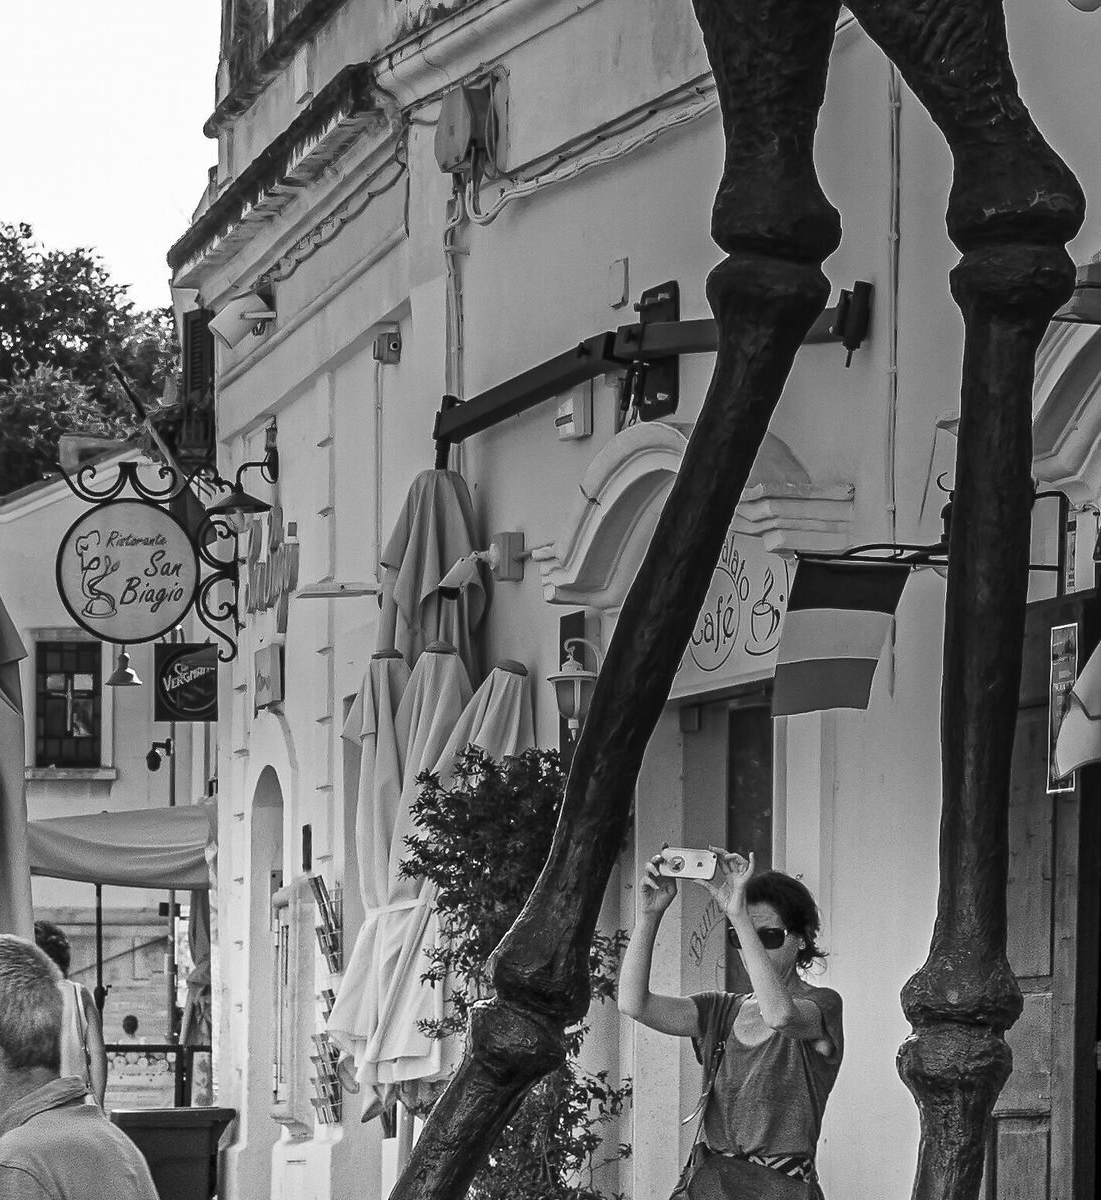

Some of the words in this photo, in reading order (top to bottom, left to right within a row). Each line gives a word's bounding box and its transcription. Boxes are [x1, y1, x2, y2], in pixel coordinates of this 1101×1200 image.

[106, 530, 168, 549] Ristorante
[143, 549, 183, 578] San
[119, 576, 184, 614] Biagio
